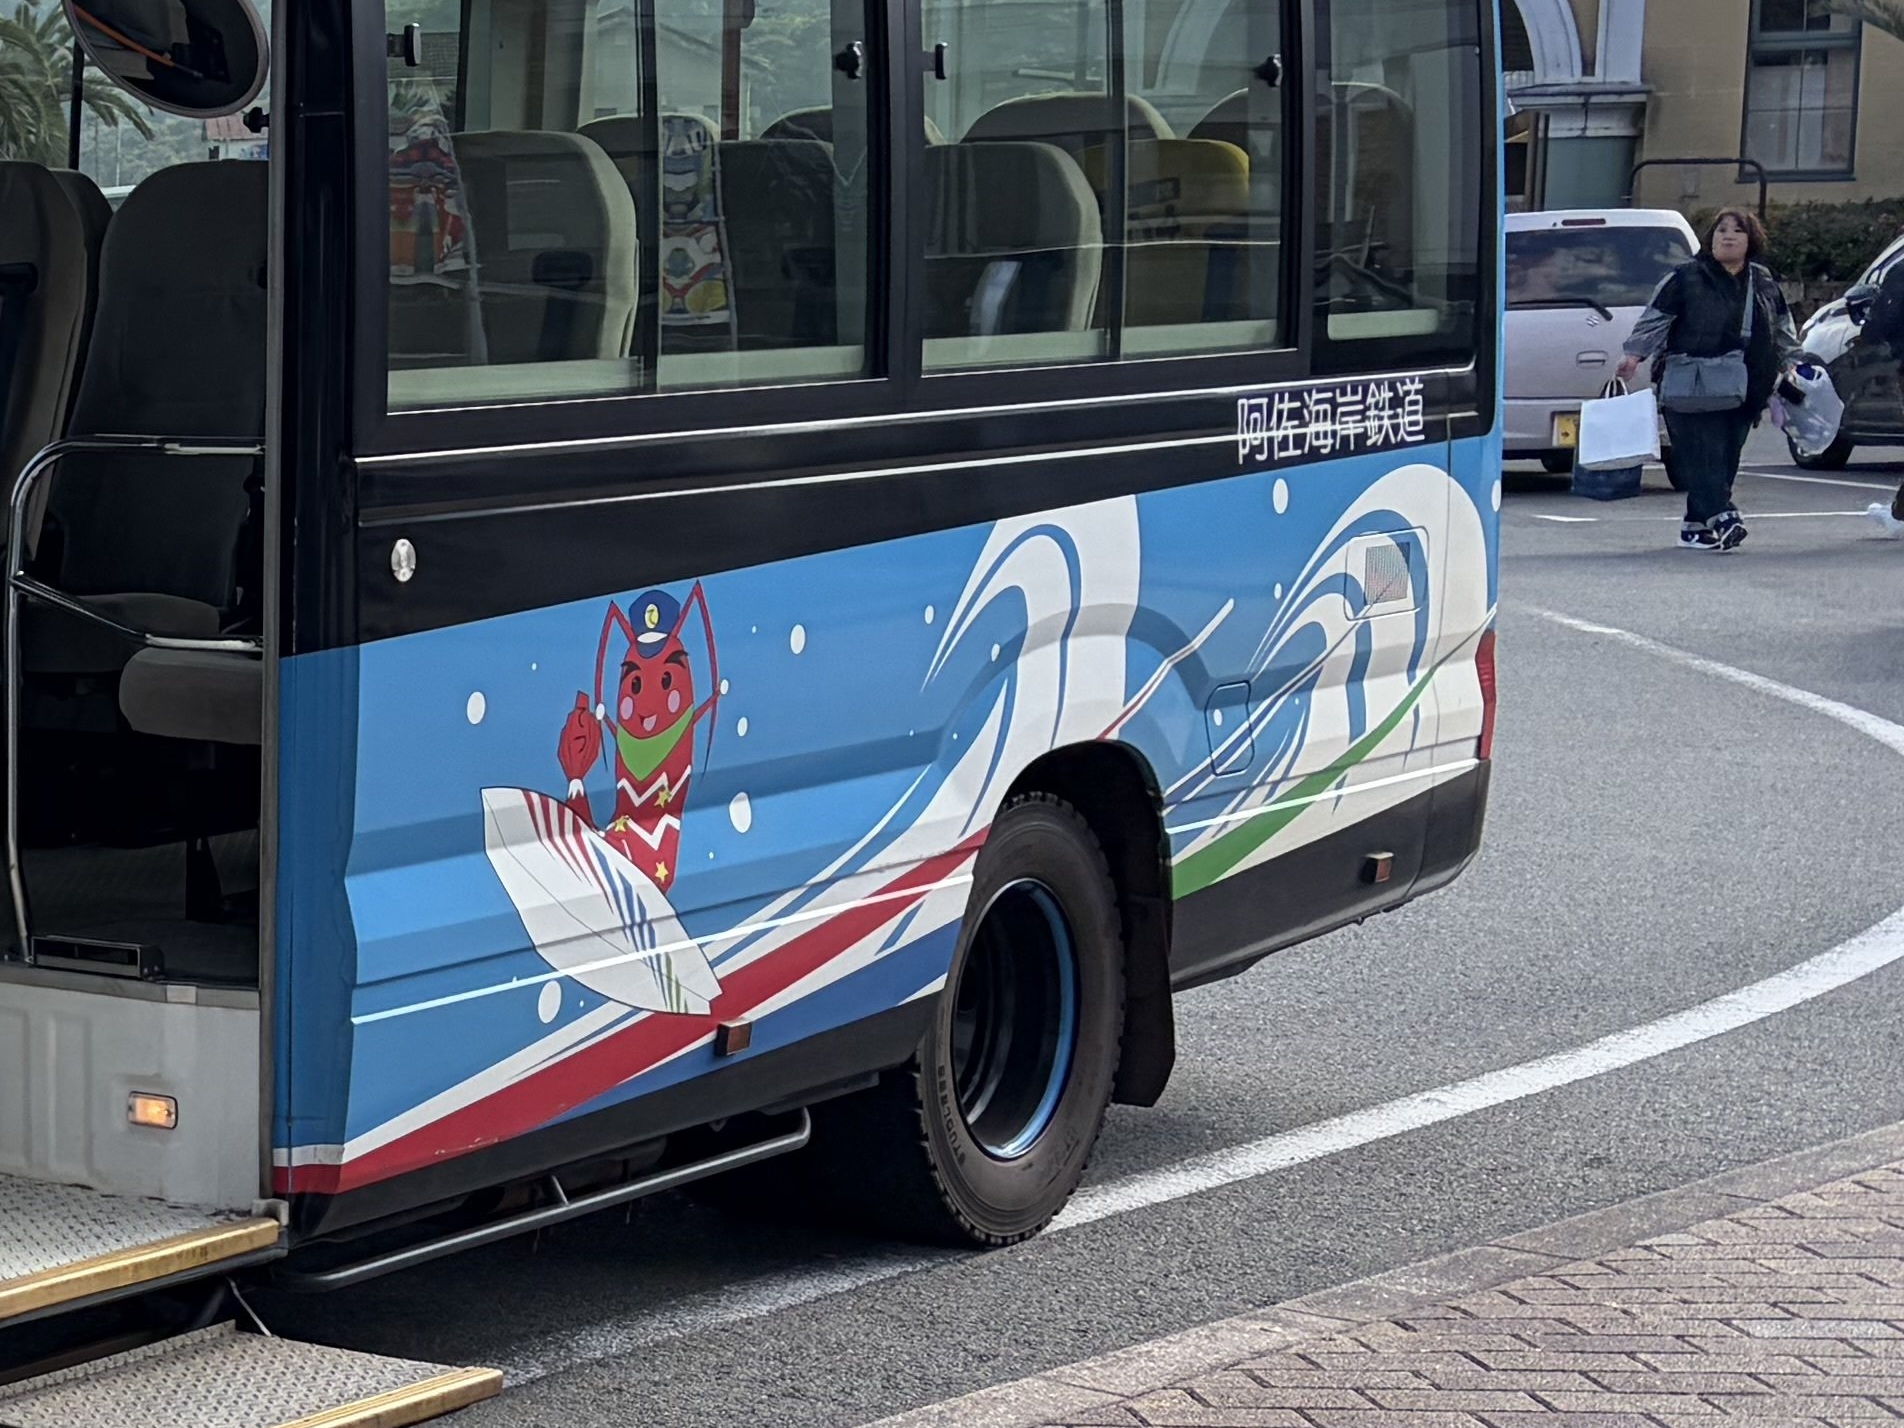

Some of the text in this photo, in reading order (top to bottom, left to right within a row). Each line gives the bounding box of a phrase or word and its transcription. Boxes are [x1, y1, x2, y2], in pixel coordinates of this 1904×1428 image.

[1237, 375, 1425, 465] 阿佐海岸鉄道
